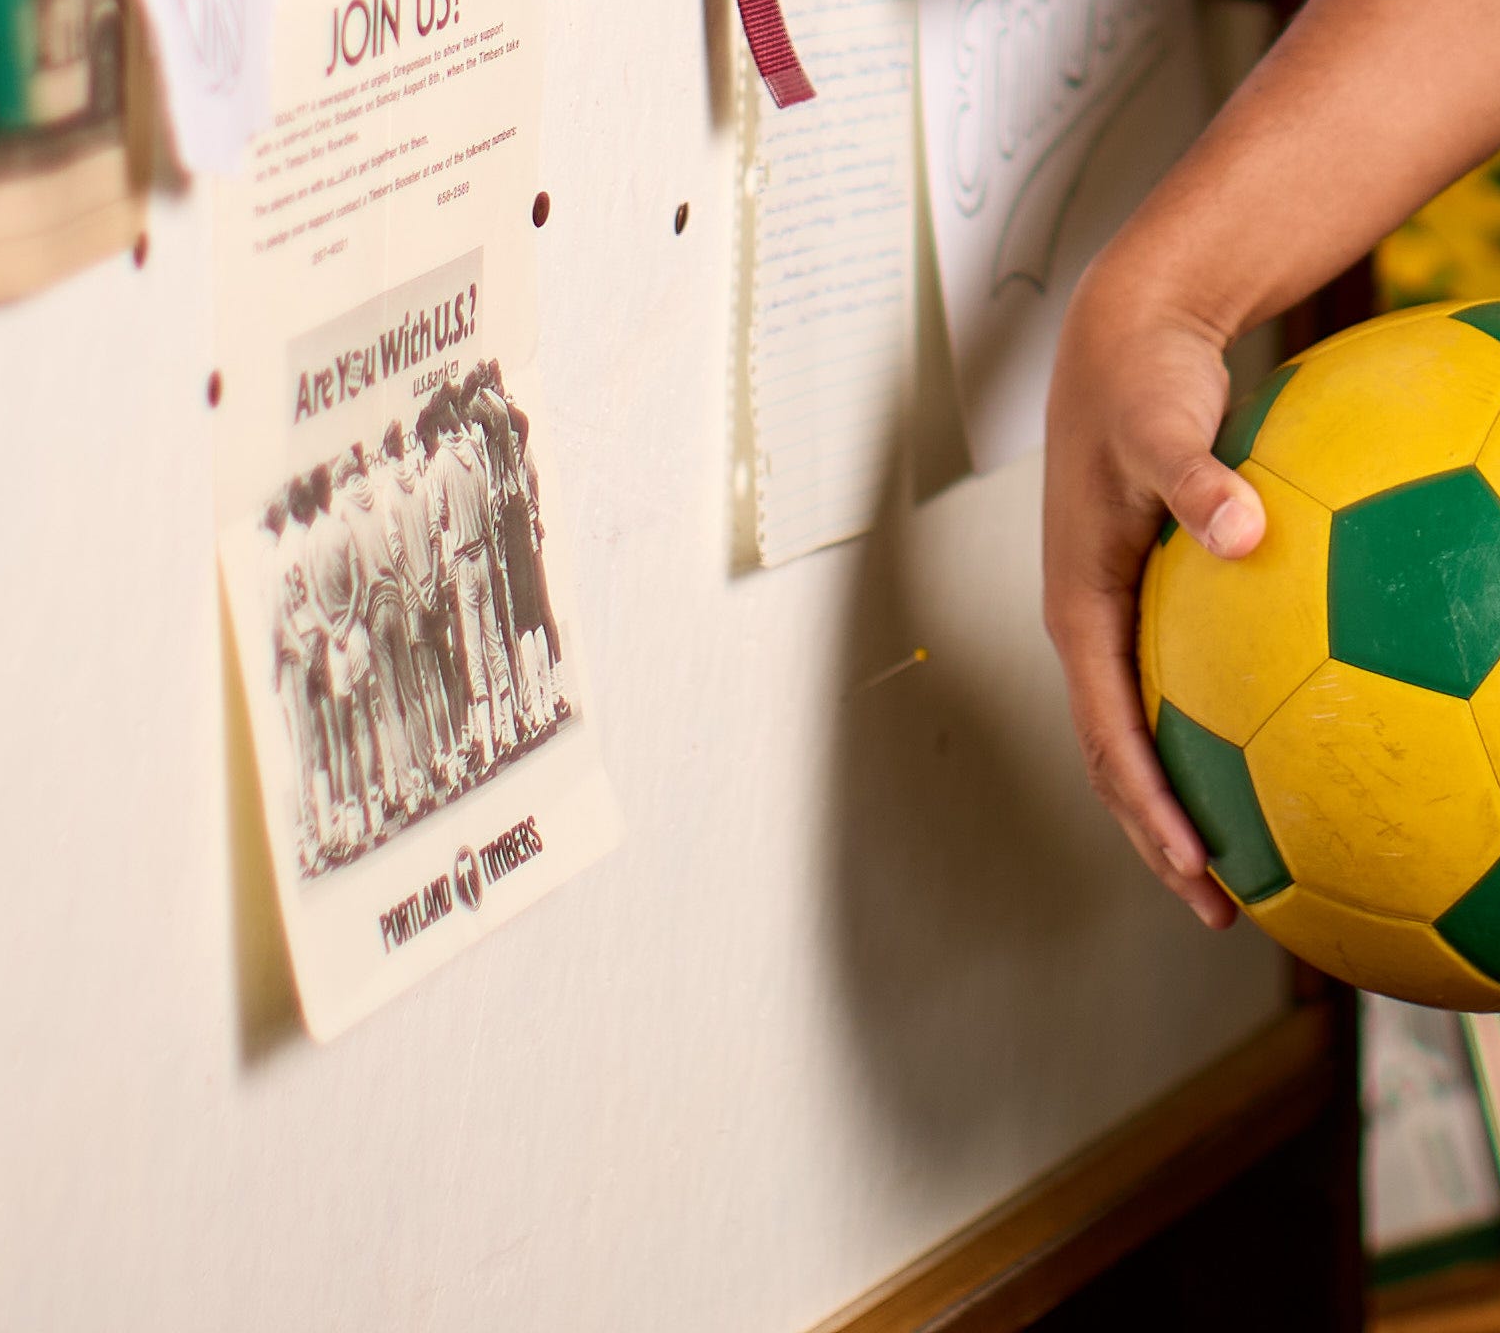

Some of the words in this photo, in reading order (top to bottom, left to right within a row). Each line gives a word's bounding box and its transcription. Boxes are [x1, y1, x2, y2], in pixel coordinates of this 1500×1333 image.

[393, 52, 431, 79] Oregonians
[434, 49, 440, 60] to
[443, 41, 460, 56] show
[463, 33, 477, 48] their
[480, 22, 503, 42] support
[403, 77, 426, 97] August
[447, 61, 464, 77] when
[466, 56, 476, 69] the
[479, 44, 503, 64] Timbers
[506, 38, 519, 52] take
[399, 141, 408, 154] for
[431, 161, 442, 173] one
[445, 156, 452, 168] of
[454, 150, 463, 164] the
[465, 138, 490, 159] following
[492, 126, 517, 144] numbers:
[293, 363, 334, 425] Are
[332, 338, 377, 399] You
[379, 310, 432, 375] With
[433, 282, 478, 356] U.S.?
[379, 869, 454, 955] PORTLAND
[479, 814, 544, 888] TIMBERS
